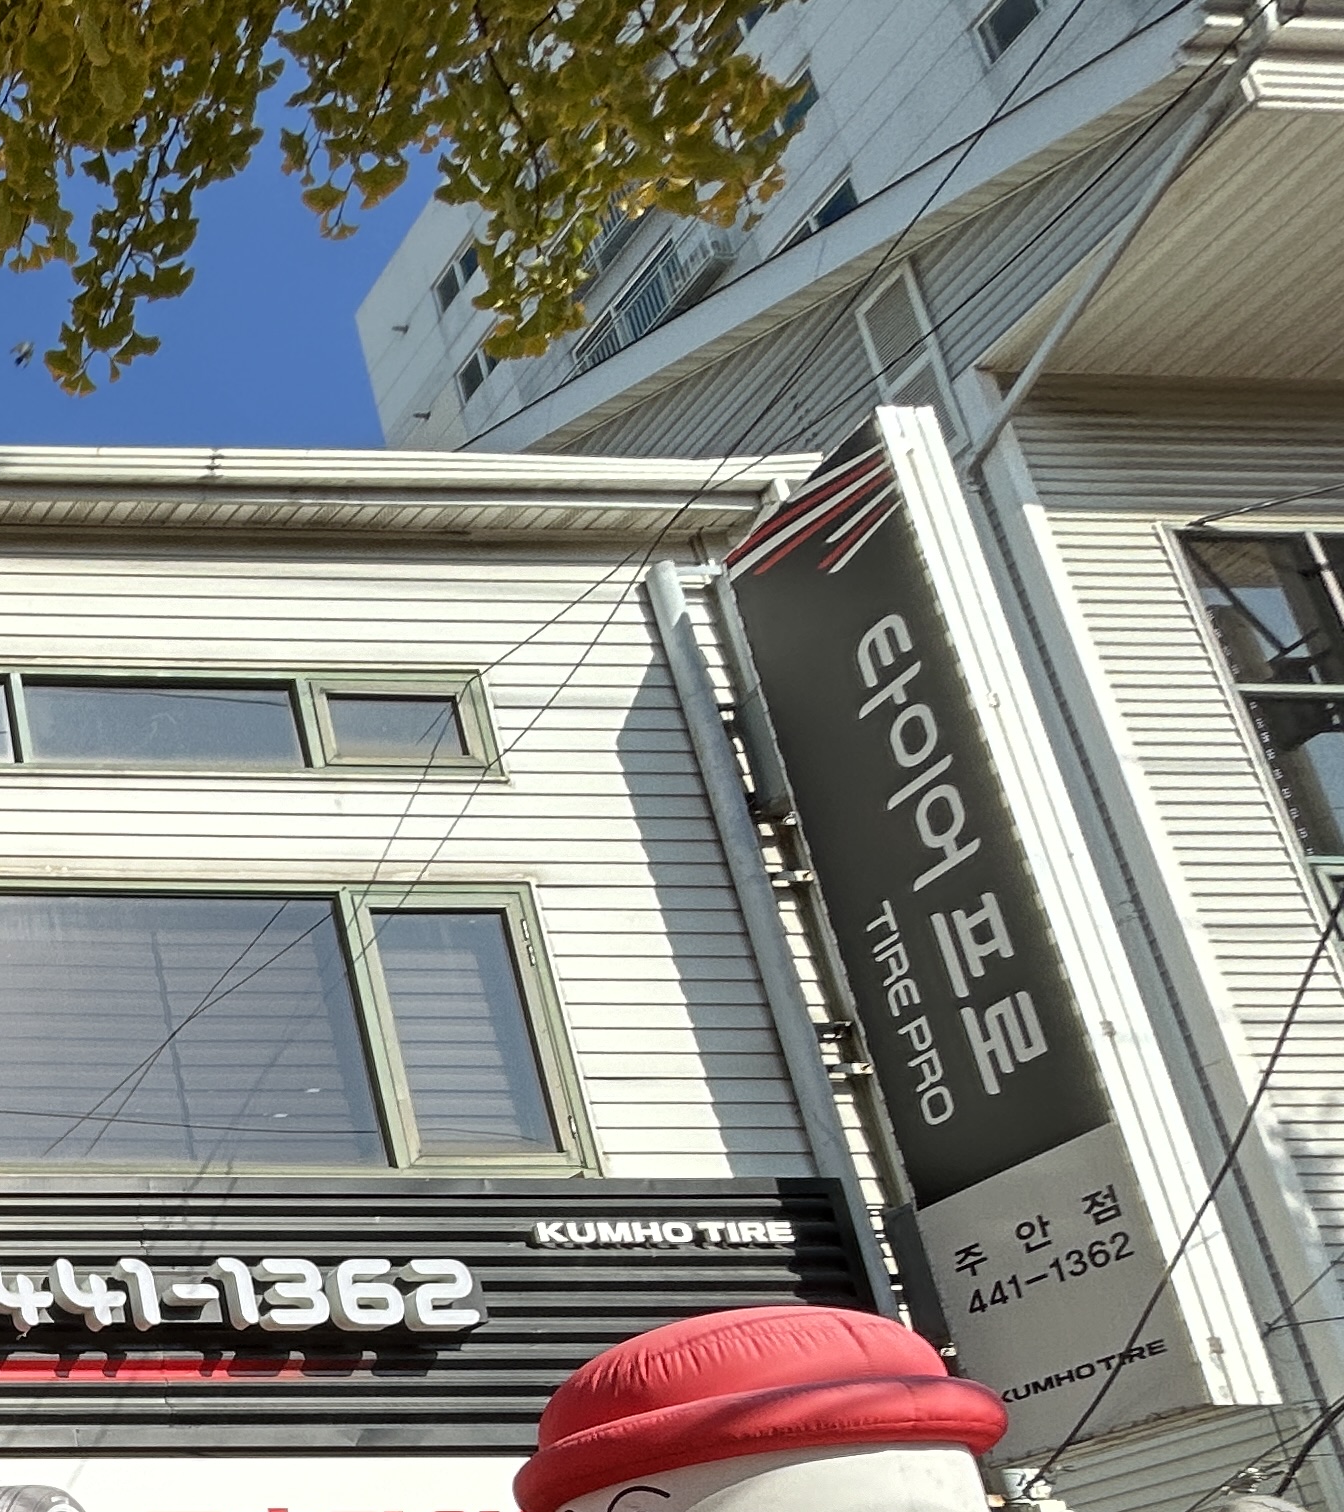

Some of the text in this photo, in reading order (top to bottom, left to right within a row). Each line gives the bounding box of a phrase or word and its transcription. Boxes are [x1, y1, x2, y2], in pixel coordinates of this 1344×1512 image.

[865, 900, 954, 1127] TIRE PRO
[534, 1219, 795, 1246] KUMHO TIRE
[968, 1231, 1135, 1314] 441-1362
[1096, 1339, 1168, 1371] TIRE
